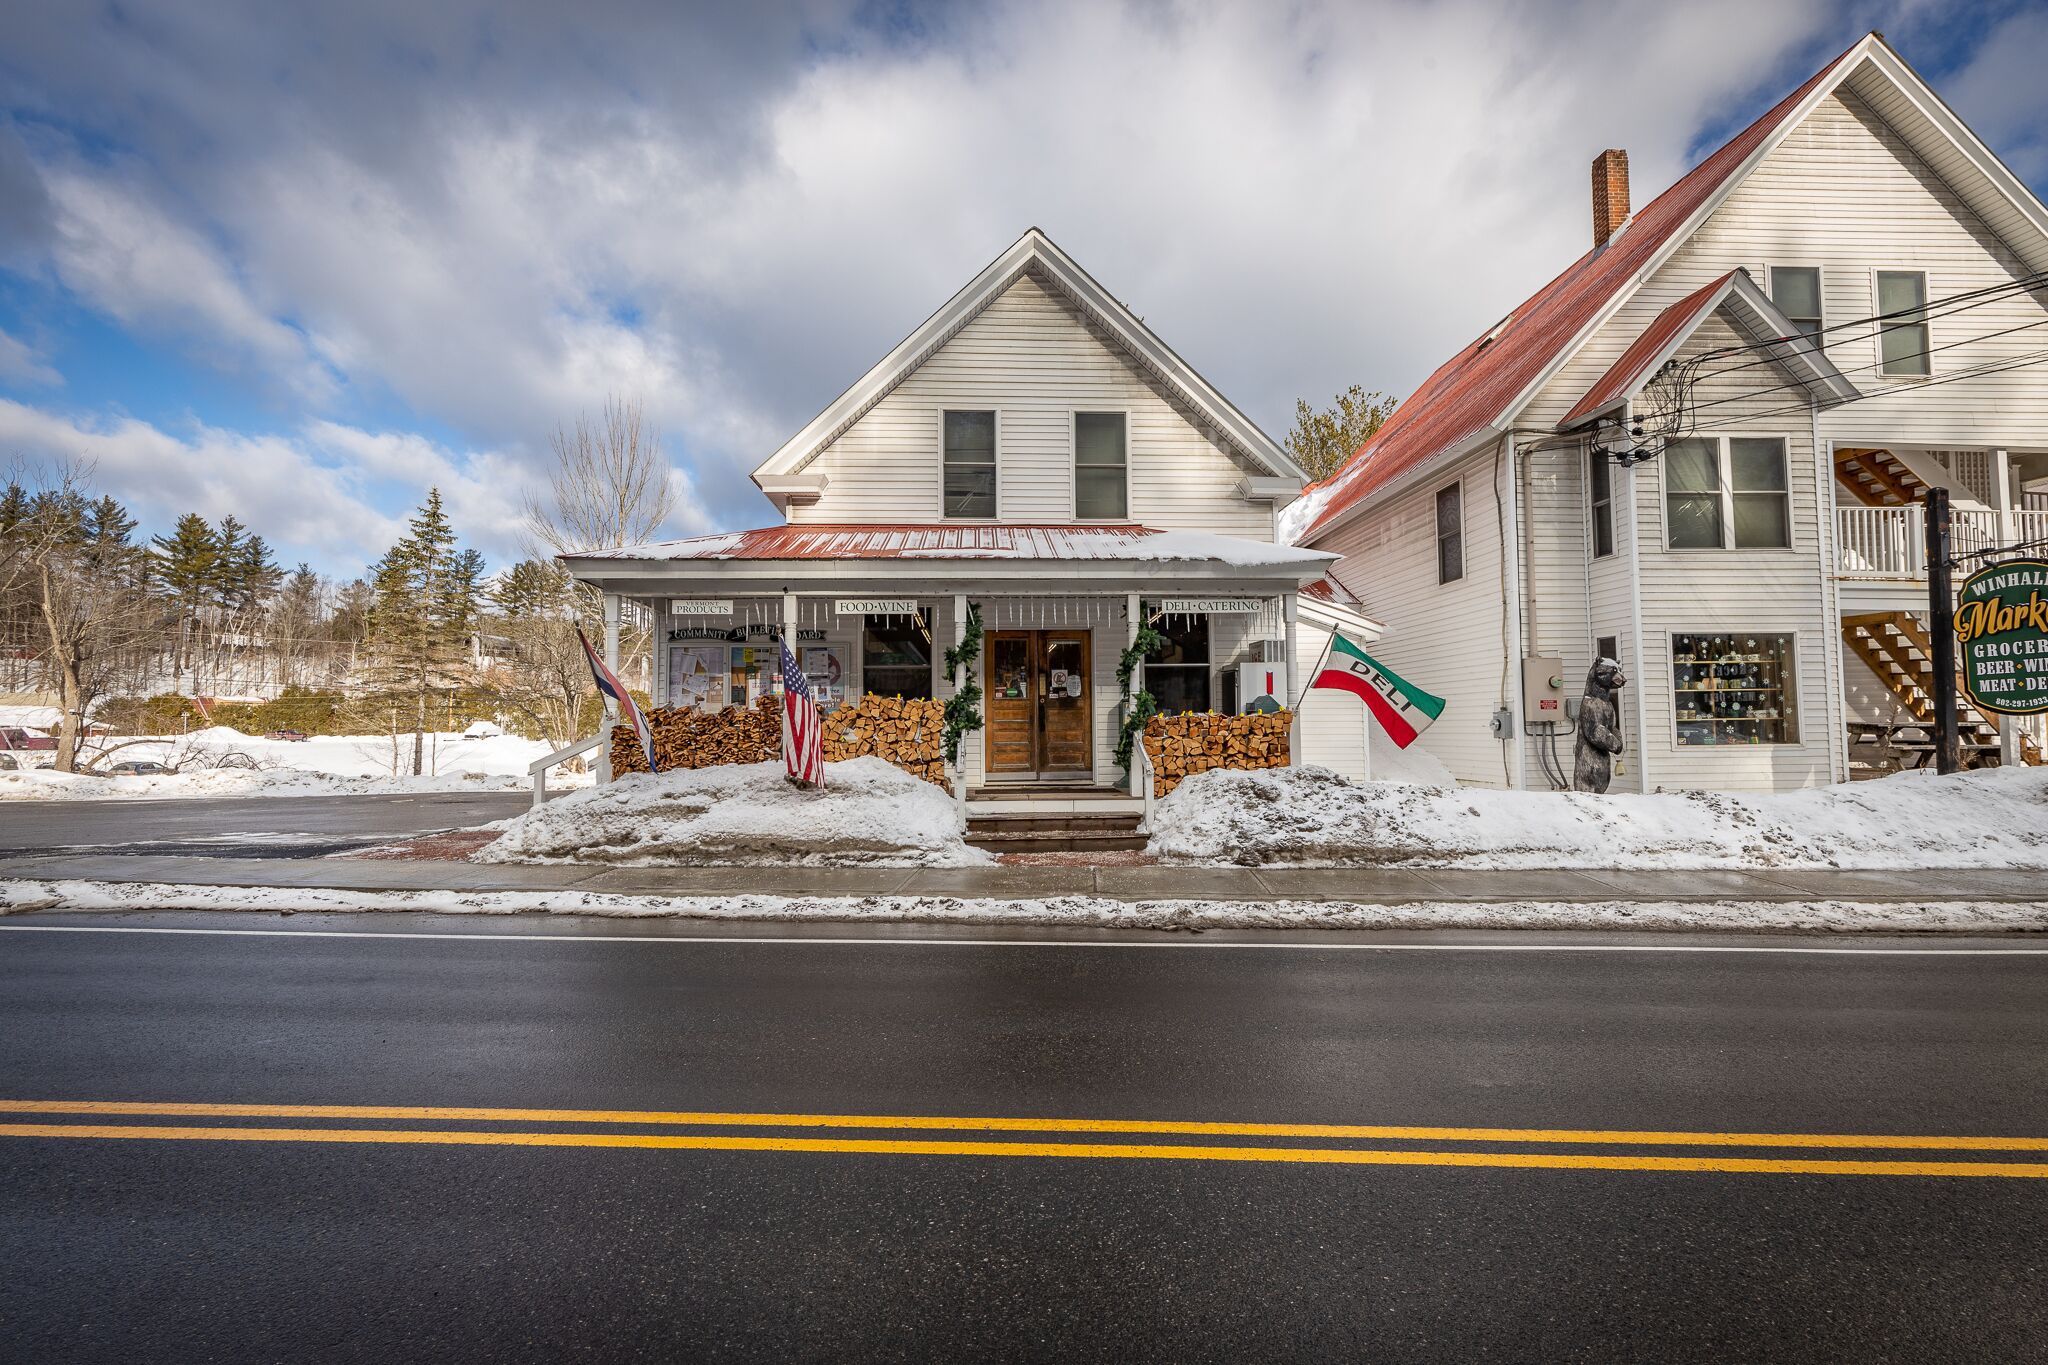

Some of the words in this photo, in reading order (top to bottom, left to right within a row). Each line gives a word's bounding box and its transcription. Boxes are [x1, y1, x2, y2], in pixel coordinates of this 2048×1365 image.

[676, 605, 729, 613] PRODUCTS
[1165, 601, 1191, 611] DELI
[1198, 601, 1260, 611] CATERING
[1953, 591, 2048, 642] Mark
[674, 629, 729, 640] COMMUNITY
[736, 625, 780, 637] BULLETI
[1976, 660, 2016, 676] BEER
[1350, 661, 1412, 713] DELI
[1979, 678, 2016, 693] MEAT
[2025, 676, 2048, 691] DE
[1995, 696, 2048, 708] 802-297-1933
